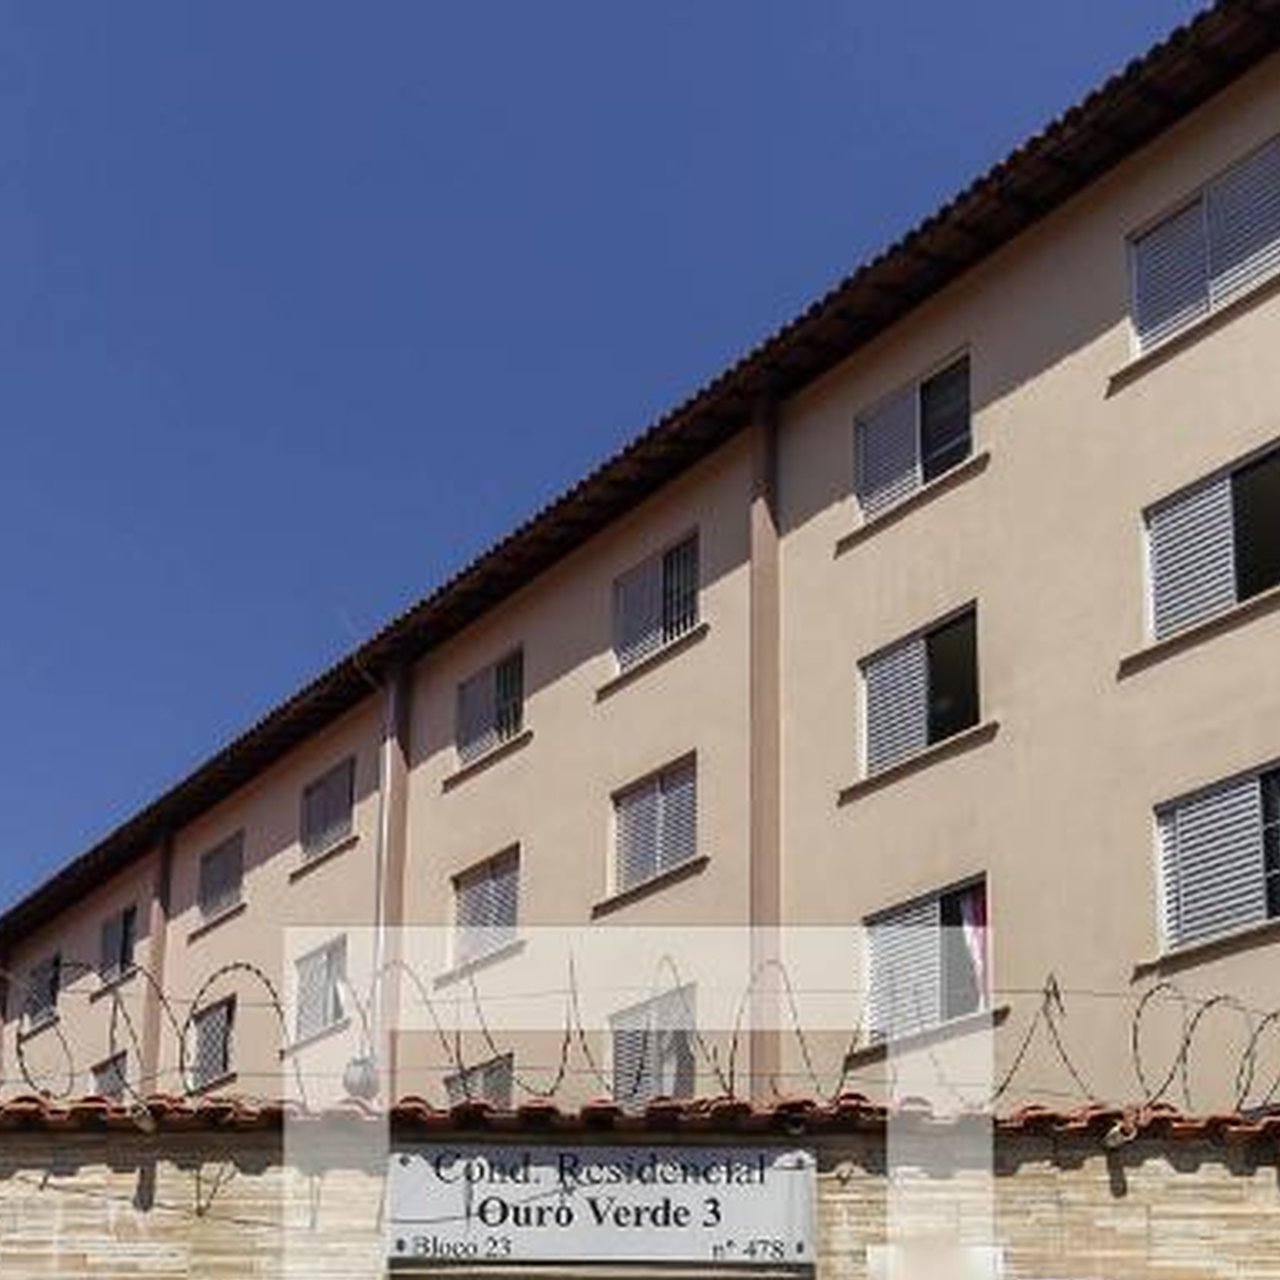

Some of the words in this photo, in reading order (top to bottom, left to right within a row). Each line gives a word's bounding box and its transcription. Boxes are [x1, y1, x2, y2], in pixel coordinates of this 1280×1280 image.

[434, 1152, 540, 1185] Cond.
[556, 1152, 766, 1186] Residencial
[478, 1195, 574, 1228] Ouro
[587, 1196, 691, 1228] Verde
[702, 1196, 722, 1228] 3
[485, 1236, 513, 1257] 23
[742, 1239, 786, 1259] 478
